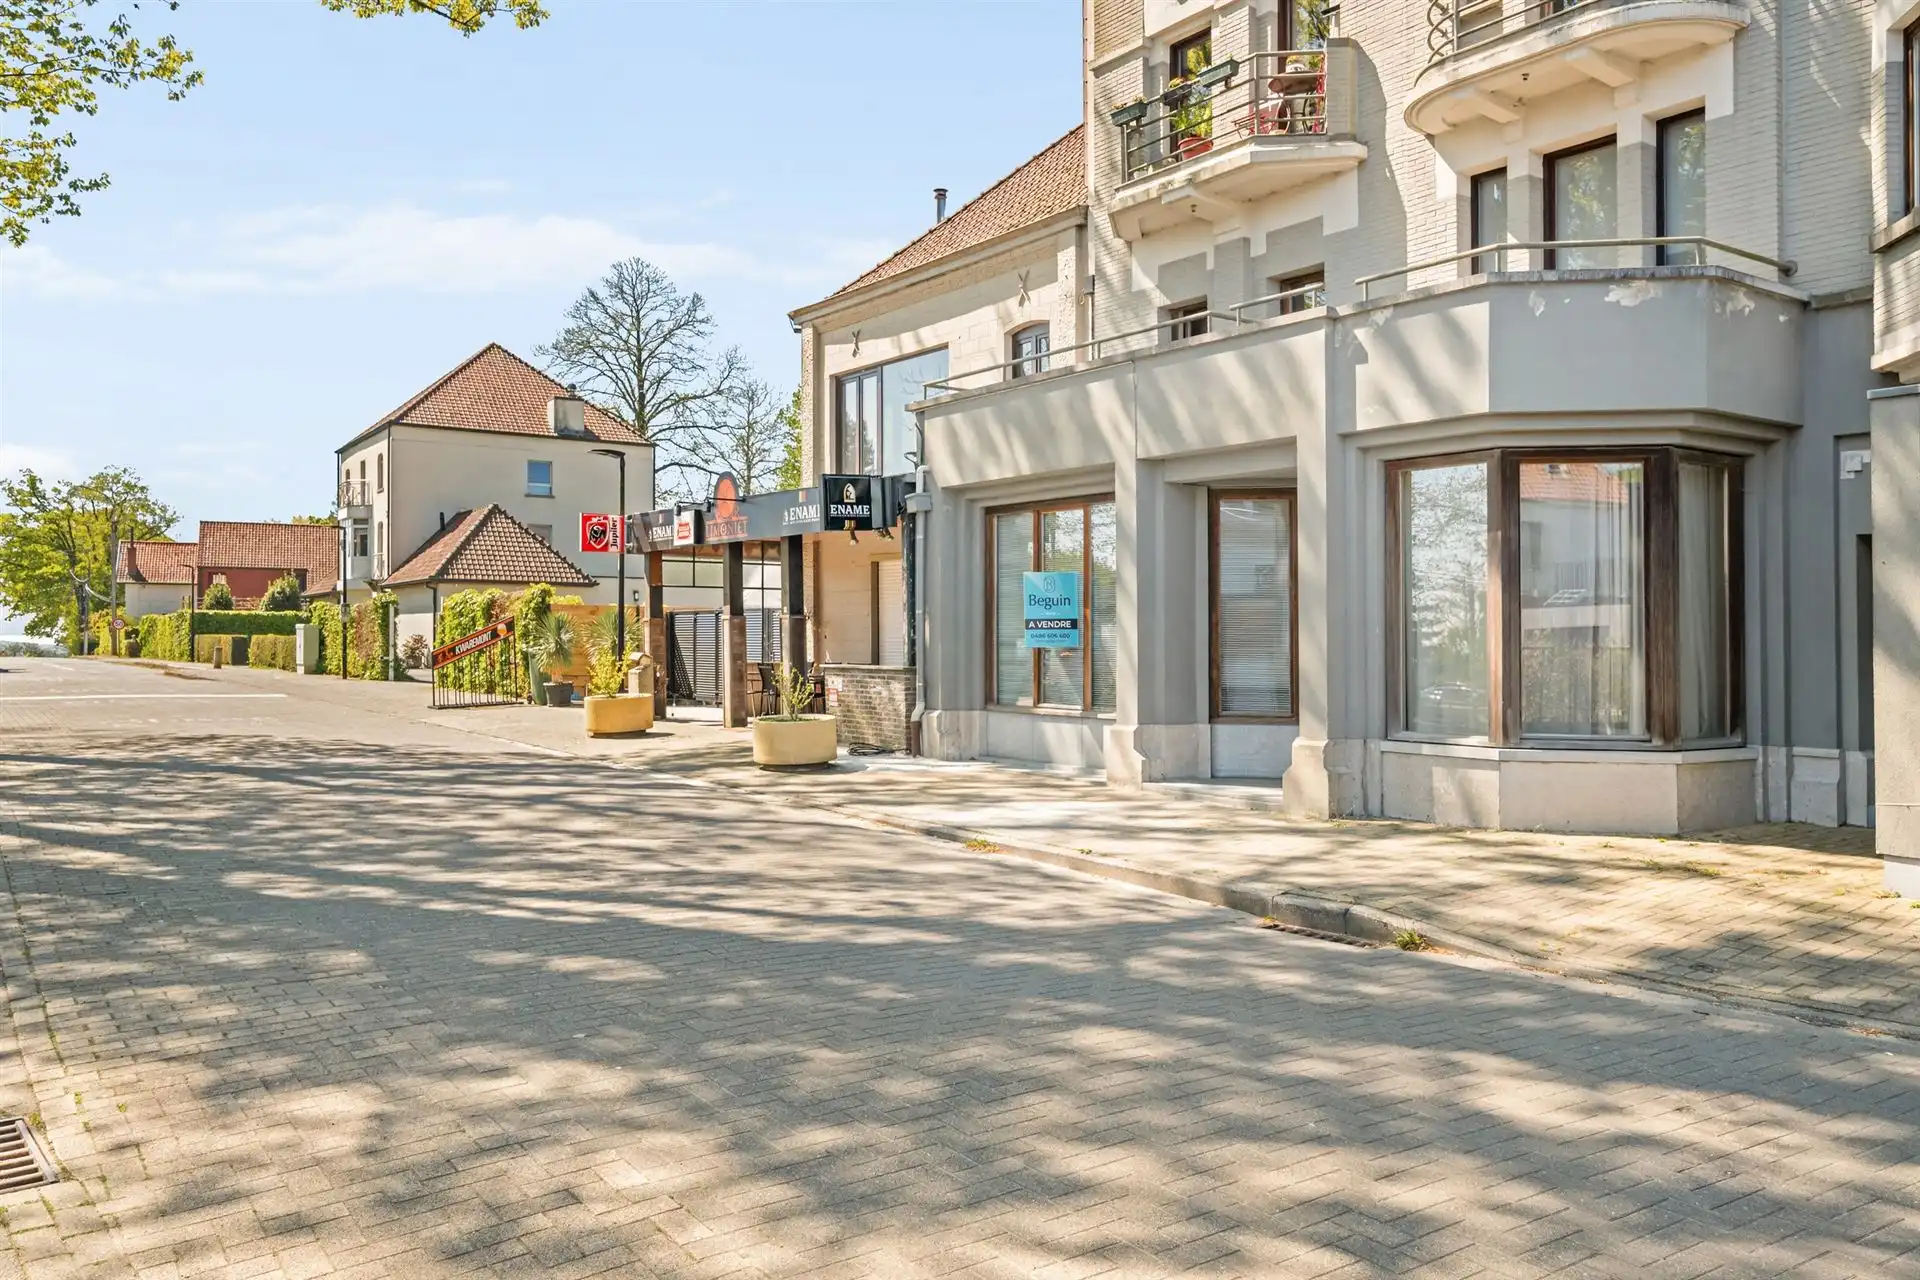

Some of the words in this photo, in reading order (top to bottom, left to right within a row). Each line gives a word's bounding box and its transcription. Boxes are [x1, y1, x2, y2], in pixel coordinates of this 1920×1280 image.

[830, 504, 870, 514] ENAME
[611, 517, 619, 549] Jupiler
[1028, 594, 1071, 610] Beguin
[1036, 620, 1071, 628] VENDRE
[455, 631, 492, 655] KWAREMONT
